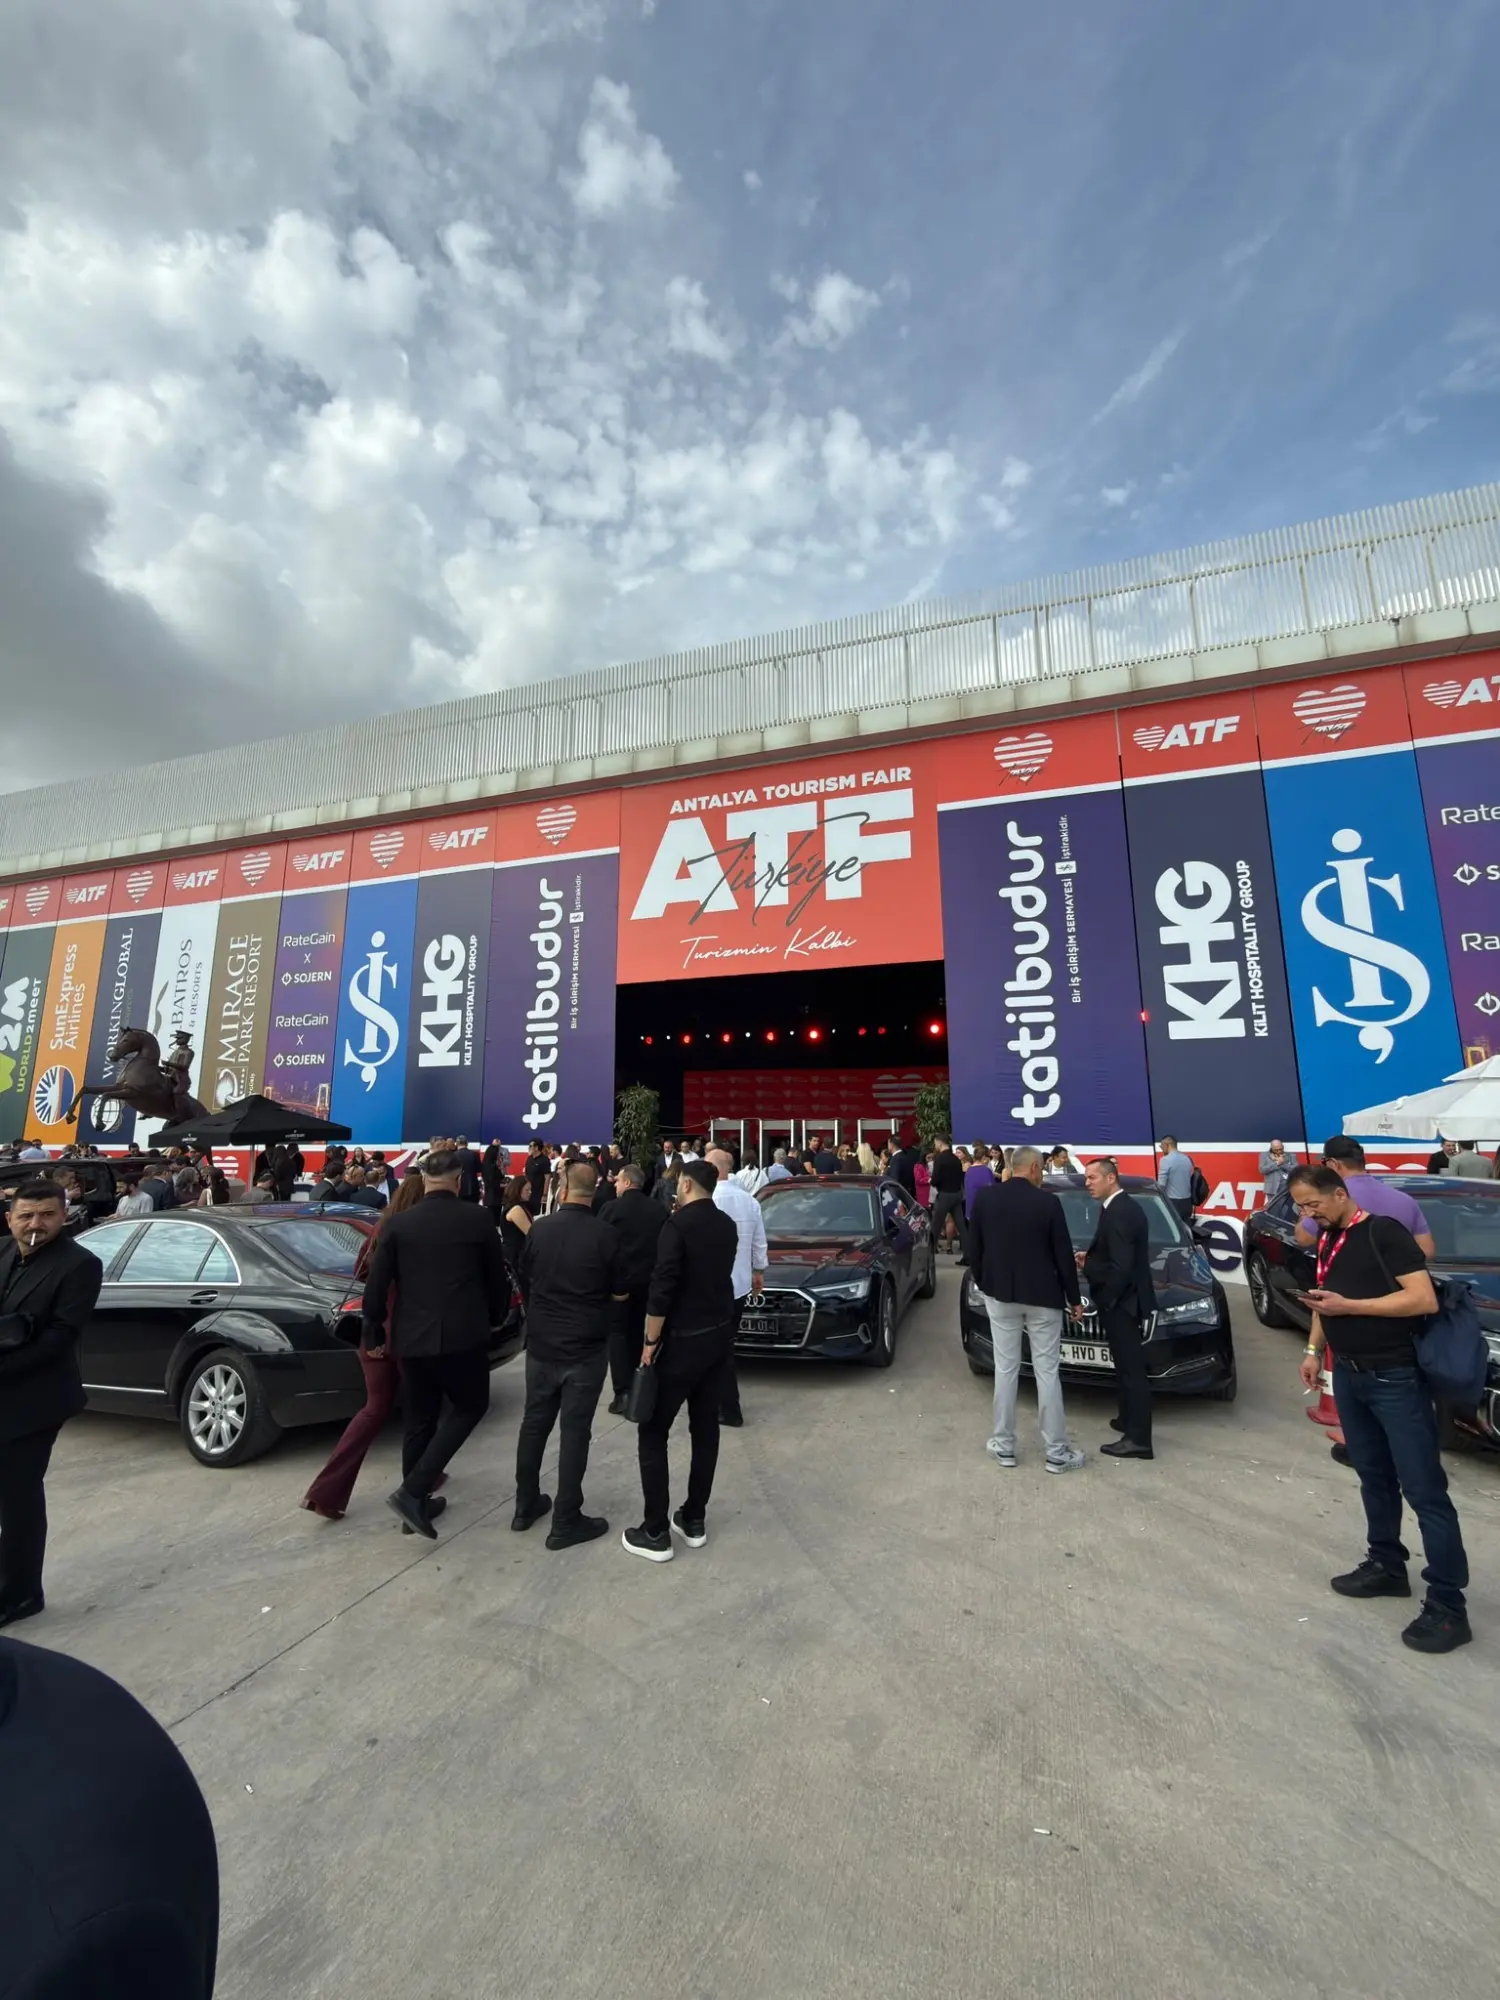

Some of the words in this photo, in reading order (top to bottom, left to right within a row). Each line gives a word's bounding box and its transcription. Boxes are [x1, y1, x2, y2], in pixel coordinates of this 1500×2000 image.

[1159, 715, 1240, 750] ATF
[669, 788, 759, 815] ANTALYA
[762, 773, 857, 801] TOURISM
[861, 766, 912, 788] FAIR
[304, 850, 345, 873] ATF
[441, 826, 489, 851] ATF
[629, 788, 914, 921] ATF
[182, 868, 219, 890] ATF
[686, 810, 871, 927] Türkiye
[1236, 859, 1254, 909] GROUP
[74, 884, 108, 904] ATF
[1061, 878, 1076, 934] SERMAYESİ
[283, 932, 336, 948] RateGain
[468, 934, 479, 972] GROUP
[679, 935, 778, 970] Turizmin
[783, 925, 858, 960] Kalbi
[1155, 861, 1246, 1040] KHG
[1241, 911, 1265, 1000] HOSPITALITY
[189, 961, 204, 1017] RESORTS
[243, 934, 263, 1007] RESORT
[293, 970, 332, 984] SOJERN
[999, 820, 1061, 1127] tatilbudur
[1071, 987, 1081, 1003] Bir
[50, 943, 78, 1051] SunExpress
[64, 983, 86, 1050] Airlines
[217, 934, 249, 1064] MIRAGE
[275, 1013, 329, 1028] RateGain
[418, 933, 467, 1068] KHG
[464, 973, 477, 1039] HOSPITALITY
[522, 877, 564, 1130] tatilbudur
[238, 1013, 255, 1063] PARK
[570, 1017, 578, 1030] Bir
[286, 1053, 326, 1066] SOJERN
[1203, 1181, 1269, 1210] AT
[1071, 1345, 1096, 1361] HVD
